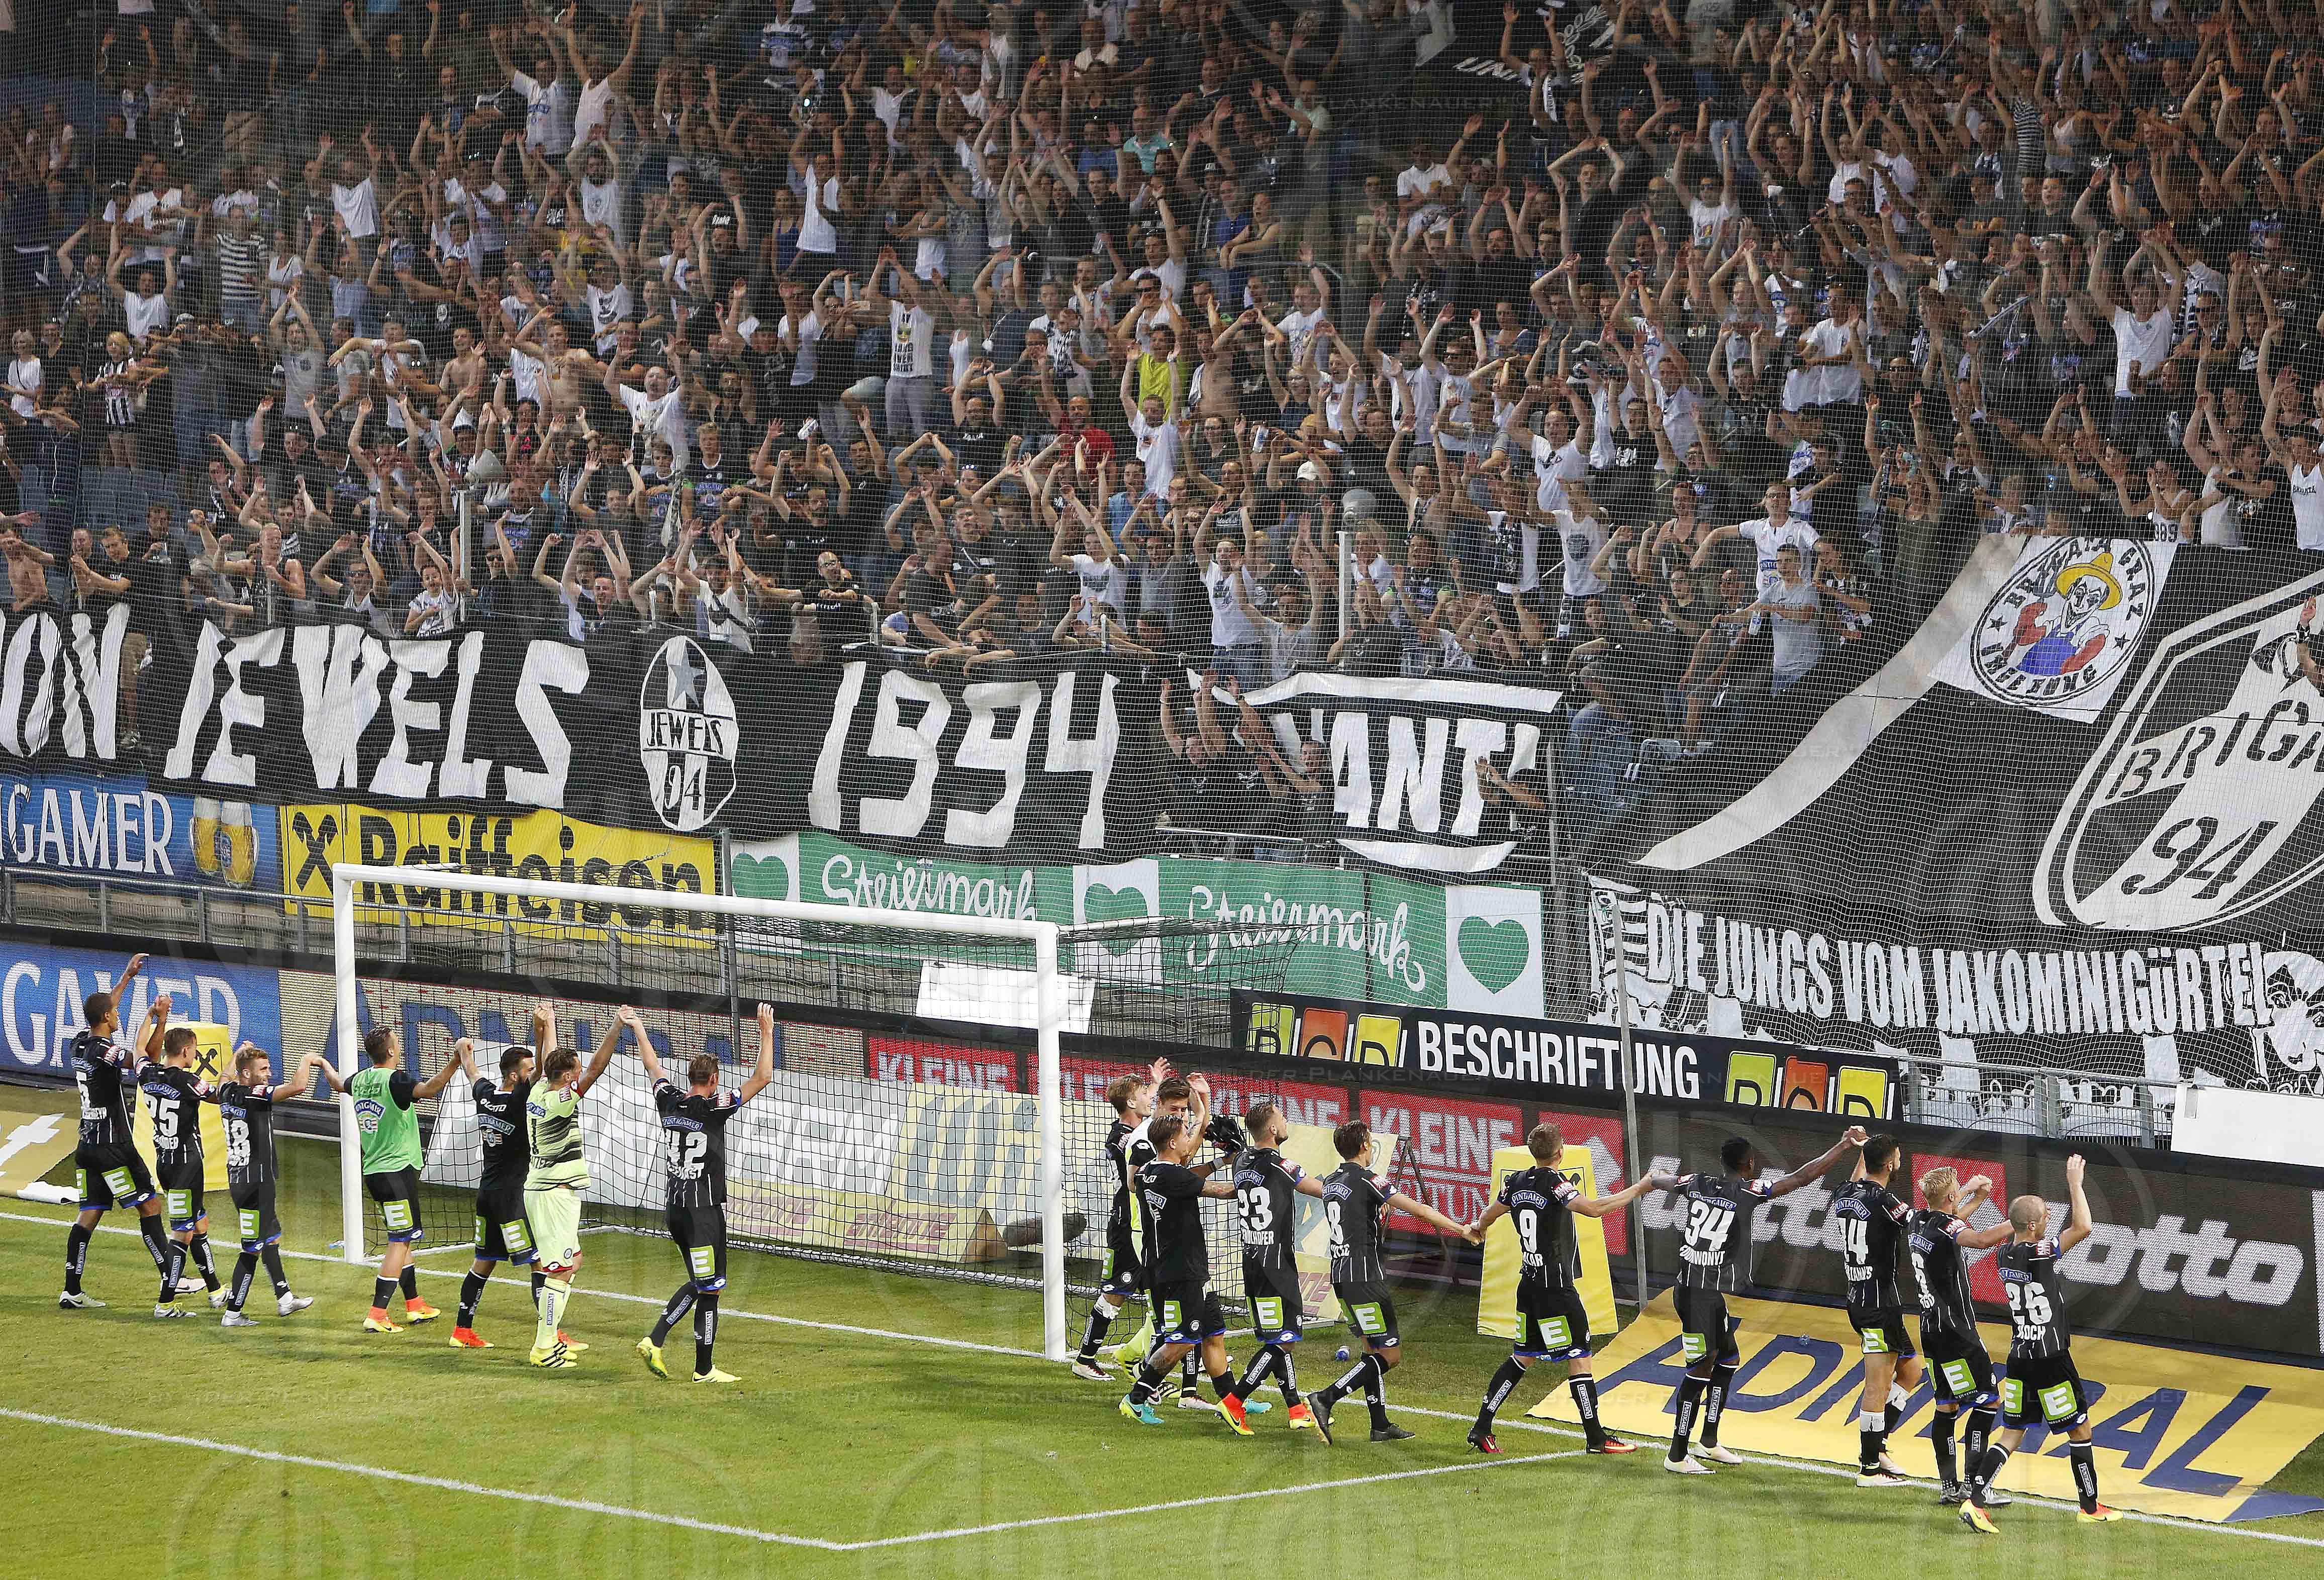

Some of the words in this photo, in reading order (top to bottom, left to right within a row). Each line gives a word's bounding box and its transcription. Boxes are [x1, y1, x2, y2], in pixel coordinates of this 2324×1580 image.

[0, 603, 130, 759] ON
[809, 661, 1121, 850] 1994
[663, 764, 704, 812] 94
[0, 782, 174, 875] GAMER
[359, 814, 703, 931] Raiffeisen
[2121, 817, 2278, 899] 94
[1187, 883, 1426, 992] Steiermark
[1647, 903, 1706, 993] DIE
[1714, 915, 1833, 1019] JUNGS
[1837, 939, 1927, 1029] VOM
[1417, 1021, 1700, 1100] BESCHRIFTUNG
[105, 1172, 131, 1196] E
[167, 1193, 186, 1216] E
[240, 1213, 255, 1236] E
[384, 1204, 408, 1227] E
[1237, 1186, 1273, 1231] 23
[1685, 1199, 1735, 1251] 34
[505, 1225, 526, 1250] E
[1519, 1209, 1537, 1253] 9
[690, 1250, 711, 1274] E
[1256, 1301, 1279, 1325] E
[1355, 1307, 1381, 1331] E
[2005, 1281, 2052, 1325] 26
[1539, 1320, 1567, 1345] E
[1943, 1364, 1970, 1392] E
[1596, 1316, 2272, 1497] ADMAL
[2043, 1387, 2072, 1416] E
